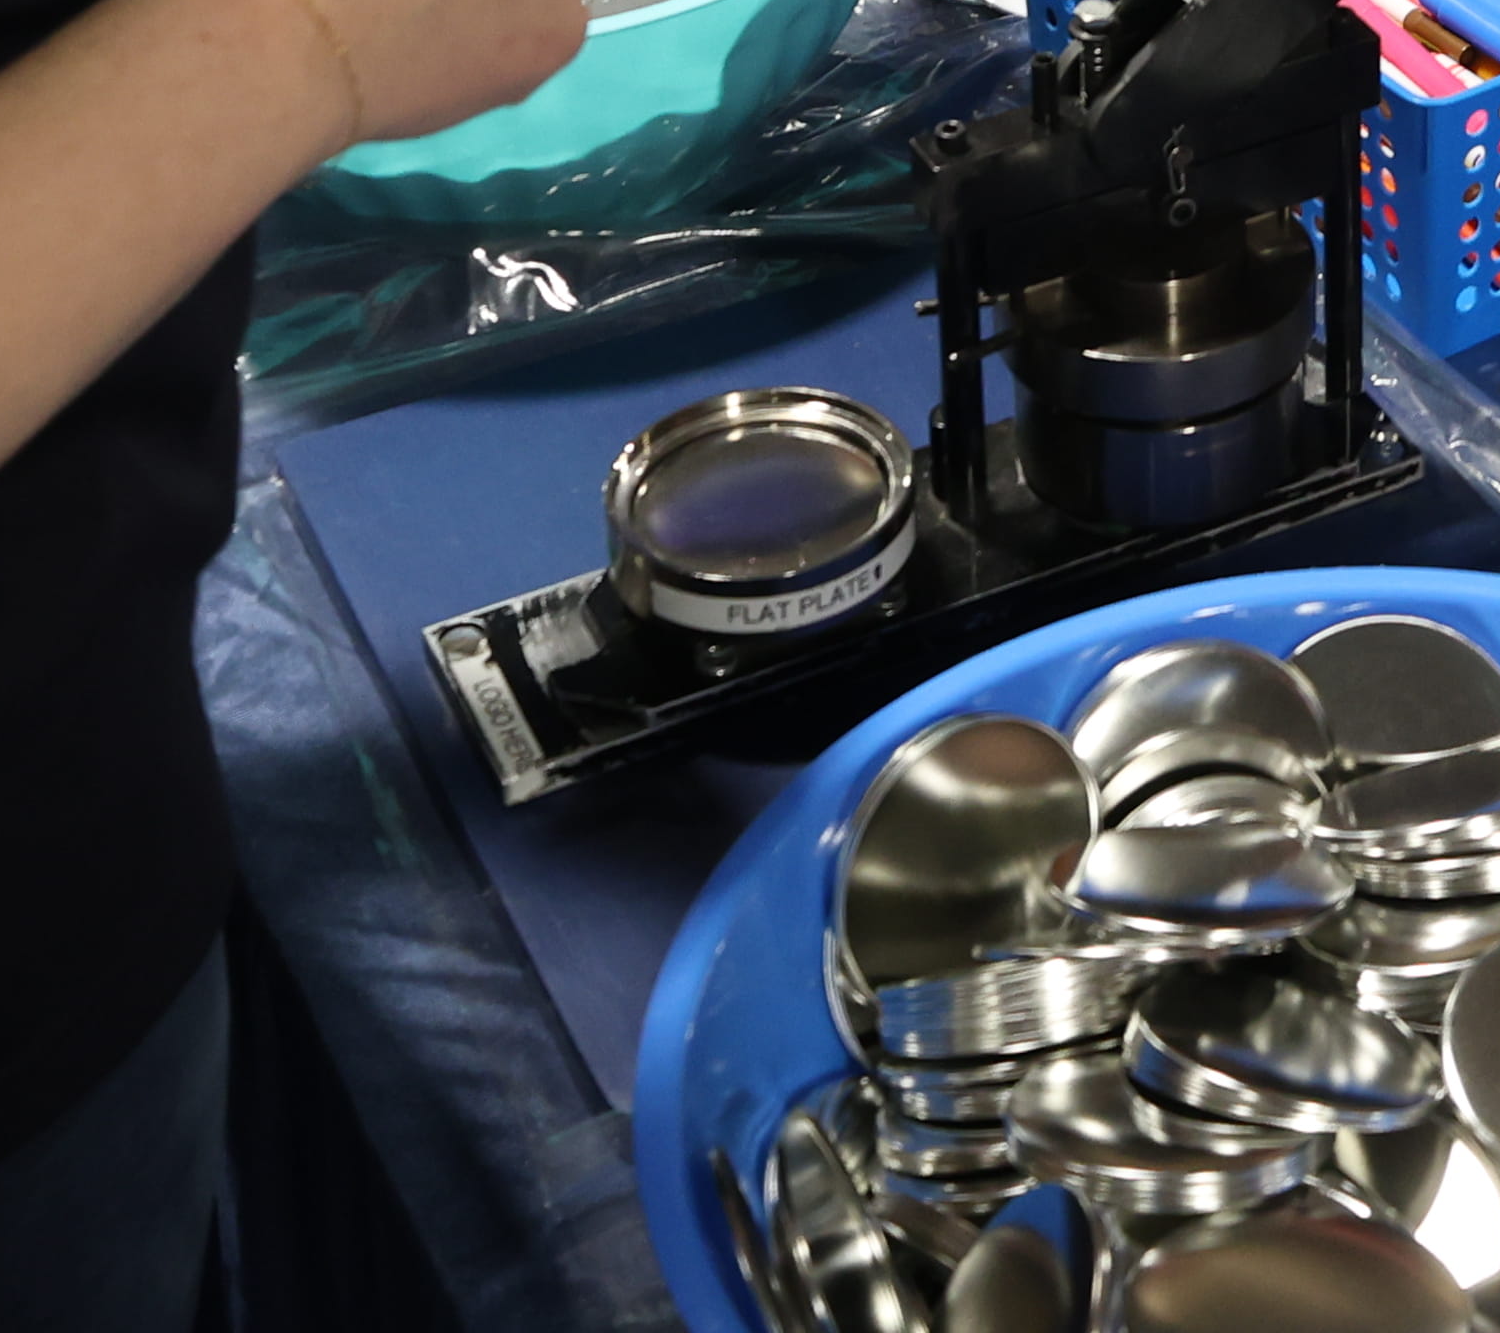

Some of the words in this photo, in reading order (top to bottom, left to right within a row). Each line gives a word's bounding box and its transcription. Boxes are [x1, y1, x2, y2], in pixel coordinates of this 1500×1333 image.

[727, 600, 791, 624] FLAT
[798, 570, 870, 616] PLATE
[474, 677, 515, 726] LOGO
